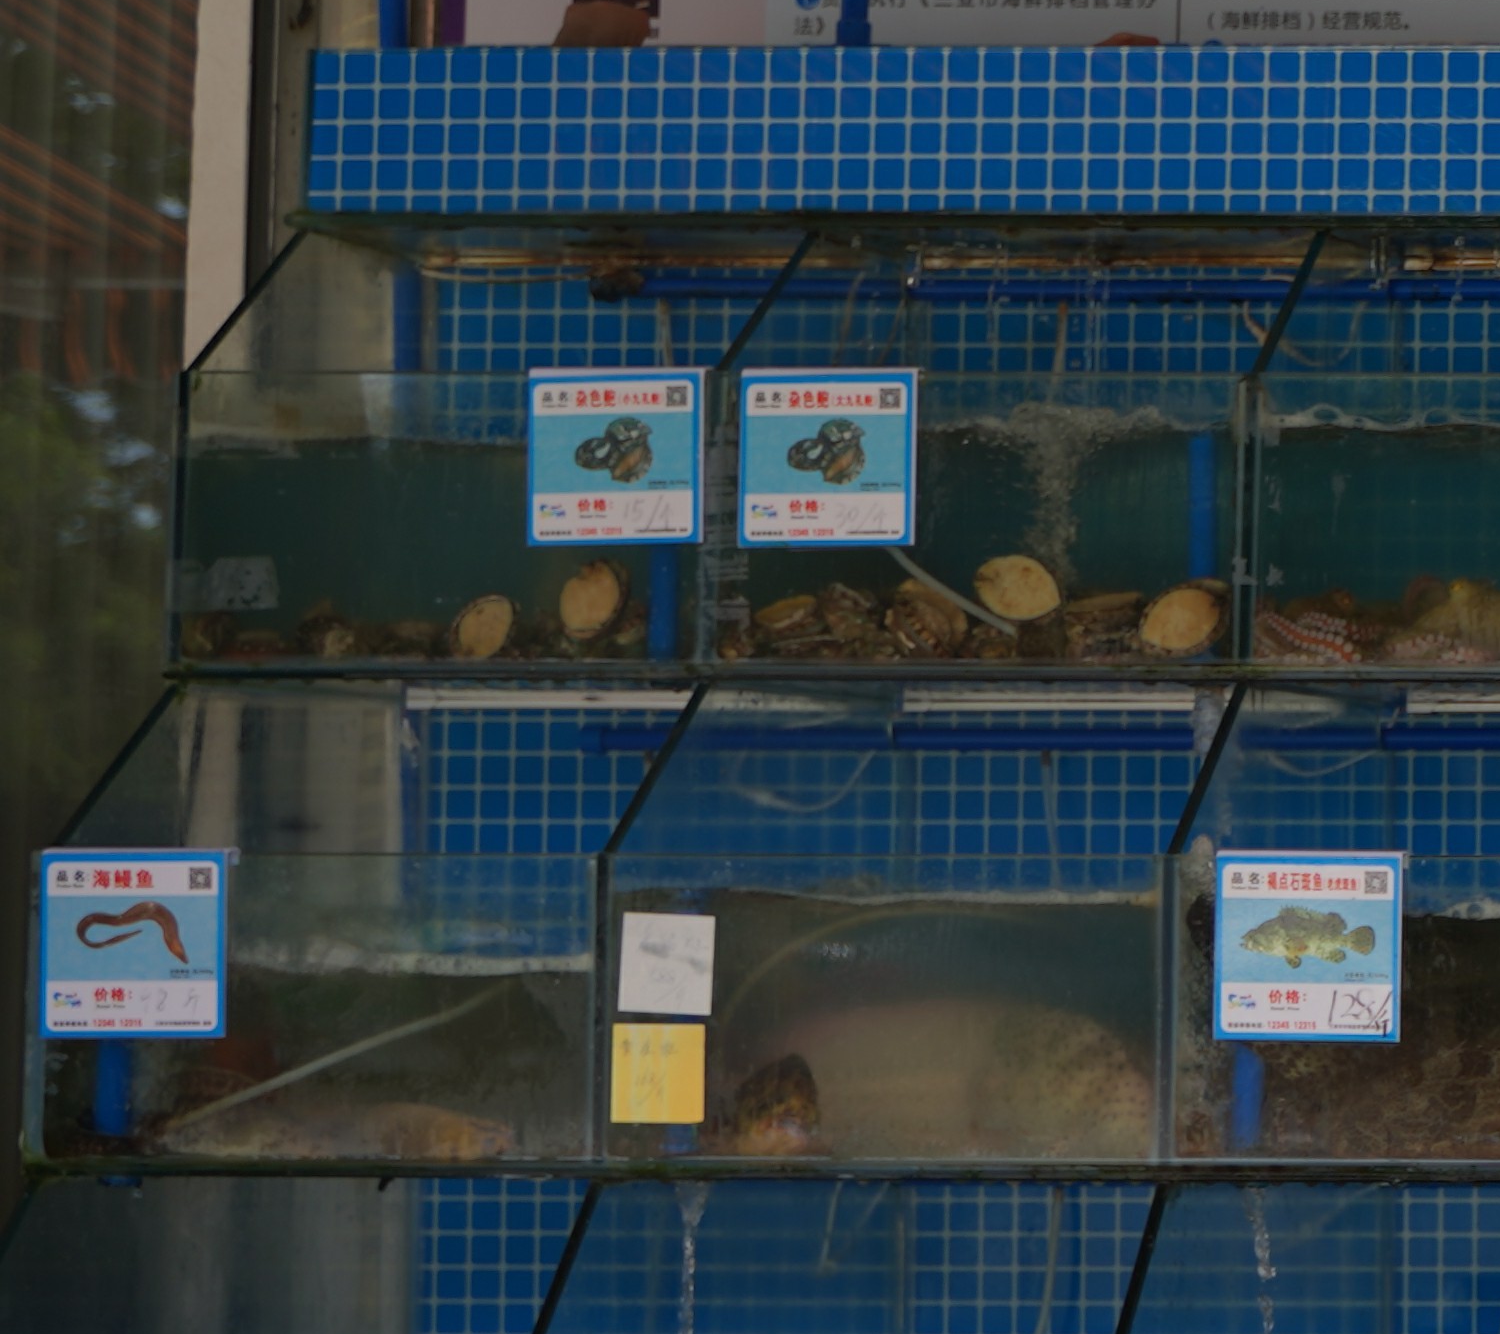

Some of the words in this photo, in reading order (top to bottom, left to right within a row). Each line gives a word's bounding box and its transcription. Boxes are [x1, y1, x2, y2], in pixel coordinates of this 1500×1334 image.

[578, 498, 614, 512] 价格:
[790, 499, 825, 512] 价格:
[94, 987, 132, 1002] 价格:
[1268, 989, 1307, 1004] 价格:
